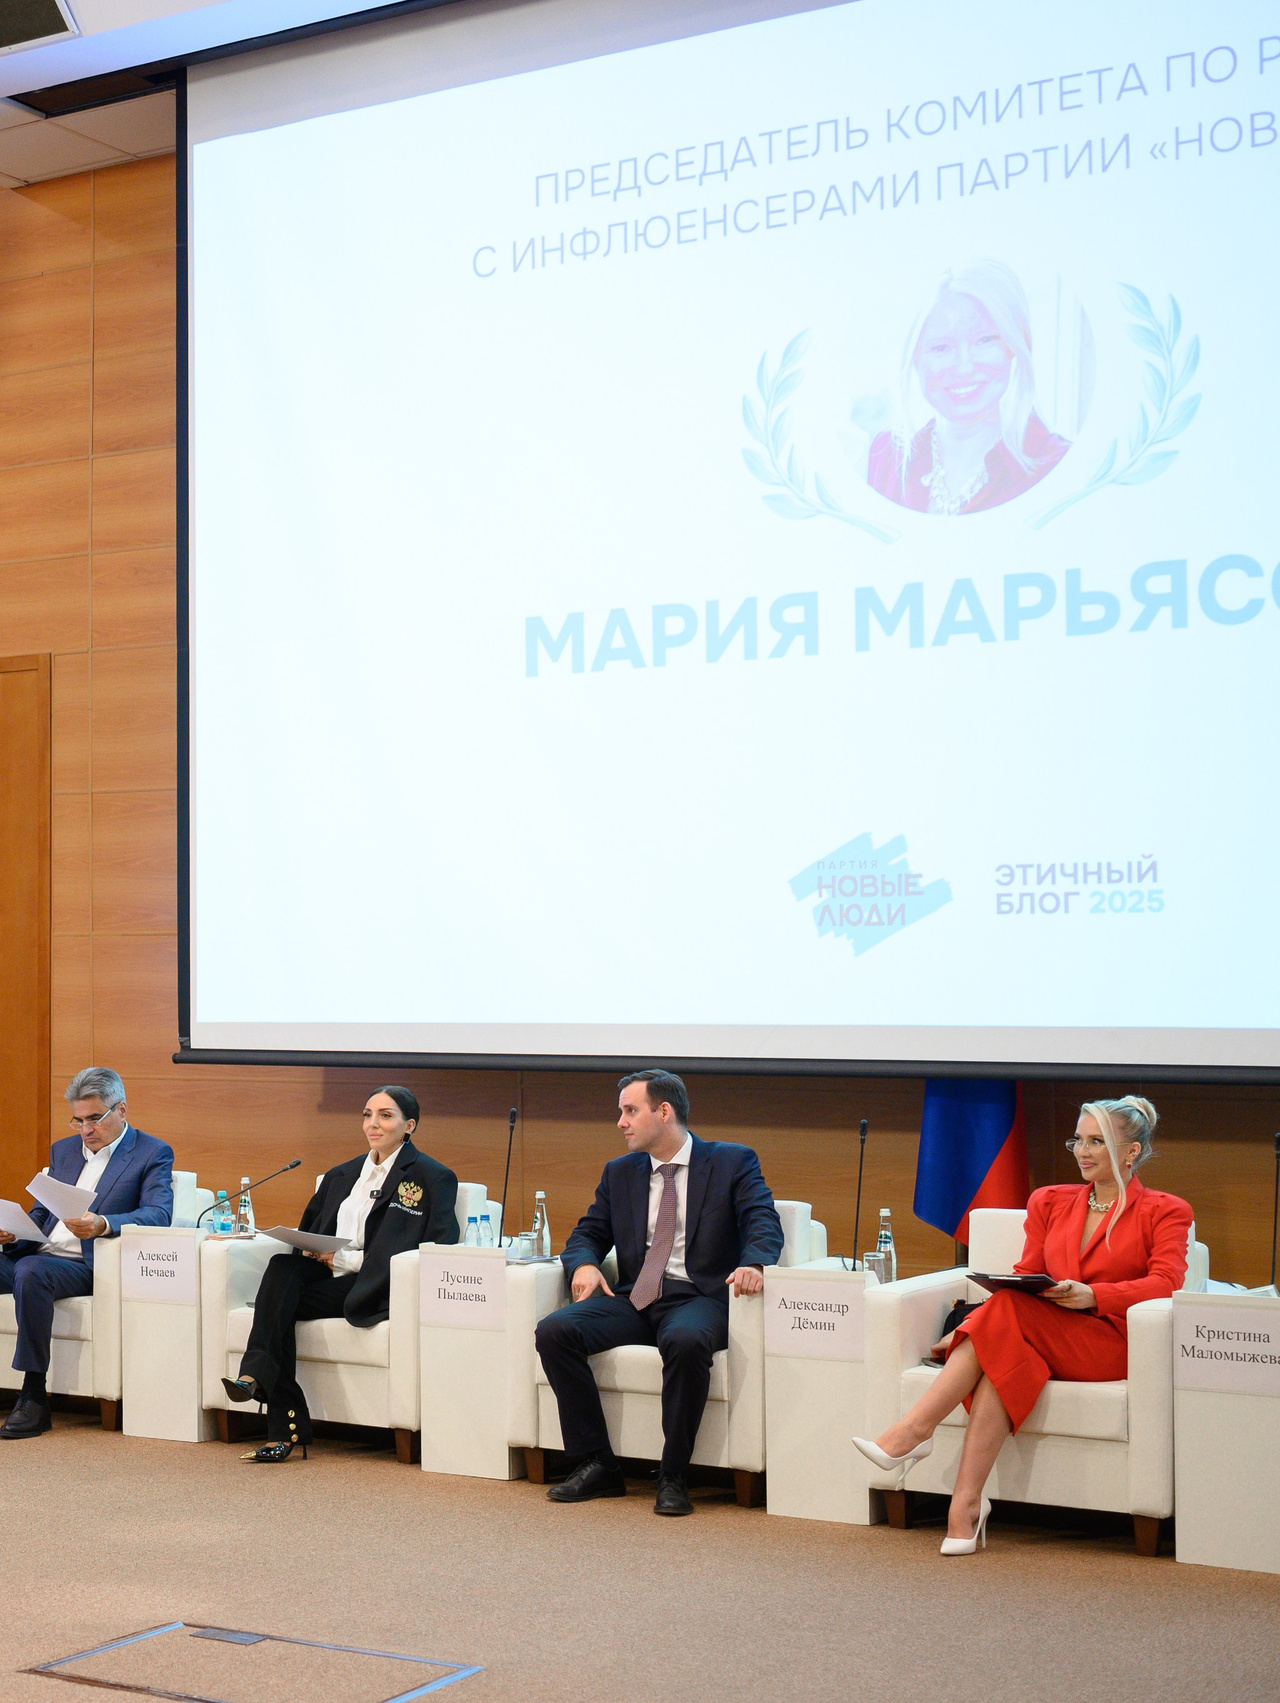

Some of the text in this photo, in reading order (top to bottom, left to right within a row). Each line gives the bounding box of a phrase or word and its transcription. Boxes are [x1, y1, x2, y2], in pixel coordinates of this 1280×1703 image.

[533, 115, 869, 208] ПРЕДСЕДАТЕЛЬ
[885, 62, 1148, 143] КОМИТЕТА
[1166, 45, 1237, 92] ПО
[472, 246, 496, 278] С
[511, 170, 921, 274] ИНФЛЮЕНСЕРАМИ
[936, 132, 1131, 202] ПАРТИИ
[524, 554, 1280, 678] МАРИЯ МАРЬЯС
[817, 859, 878, 871] ПАРТИЯ
[994, 853, 1159, 887] ЭТИЧНЫЙ
[816, 873, 924, 898] НОВЫЕ
[995, 889, 1165, 915] БЛОГ 2025
[817, 903, 907, 927] ЛЮДИ
[137, 1250, 178, 1262] Алексей
[140, 1265, 176, 1278] Нечаев
[440, 1270, 483, 1285] Лусине
[437, 1287, 487, 1302] Пылаева
[778, 1297, 849, 1316] Александр
[791, 1316, 835, 1331] Дёмин
[1195, 1324, 1271, 1343] Кристина
